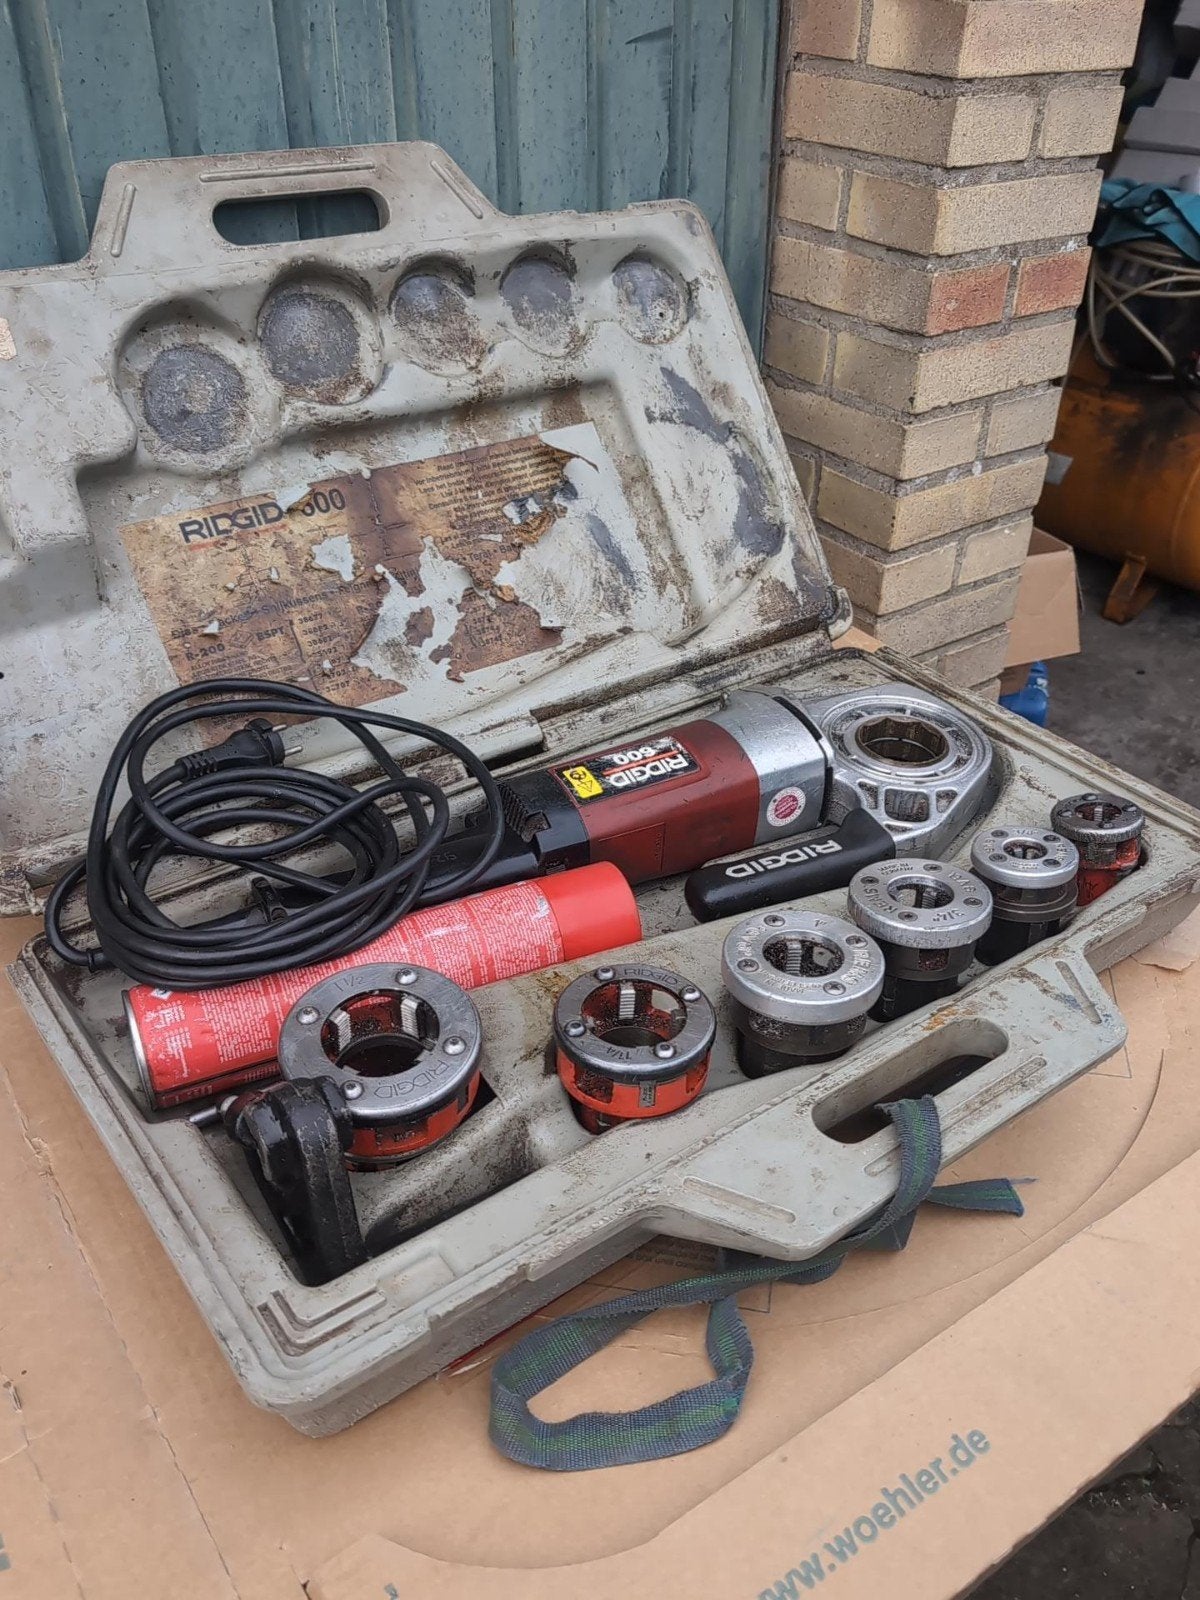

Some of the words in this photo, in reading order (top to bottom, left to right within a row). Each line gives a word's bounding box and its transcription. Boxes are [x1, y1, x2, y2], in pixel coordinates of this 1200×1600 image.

[179, 501, 284, 544] RIDGID
[606, 752, 689, 787] RIDGID
[612, 746, 655, 765] 600
[725, 839, 842, 878] RIDGID
[623, 968, 679, 985] RIDGID
[374, 1060, 449, 1099] RIDGID
